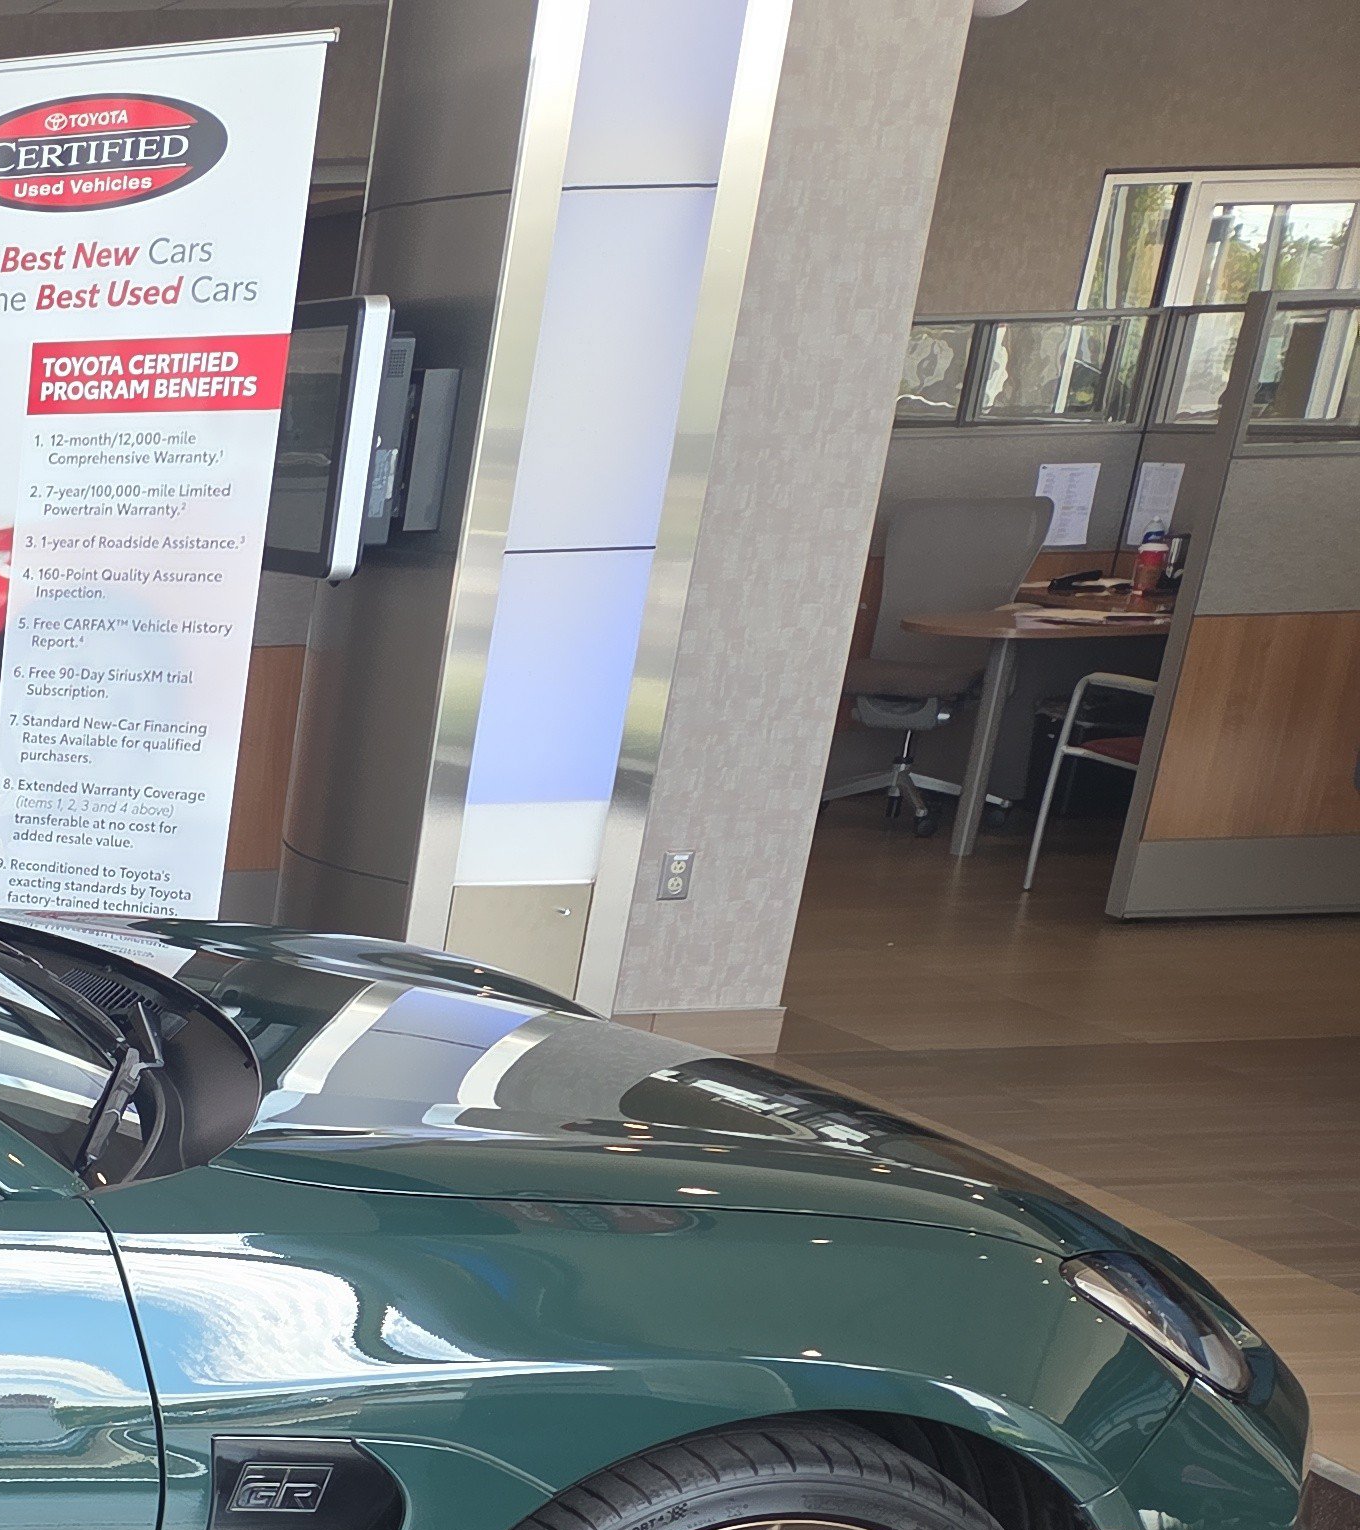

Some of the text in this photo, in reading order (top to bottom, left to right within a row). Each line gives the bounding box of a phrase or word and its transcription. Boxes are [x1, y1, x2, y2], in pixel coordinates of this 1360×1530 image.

[69, 110, 129, 127] TOYOTA
[14, 175, 153, 198] Used Vehicles
[0, 246, 66, 273] Best
[72, 242, 140, 269] New
[148, 237, 213, 265] Cars
[35, 283, 100, 311] Best
[107, 277, 184, 307] Used
[190, 276, 258, 304] Cars
[41, 351, 239, 377] TOYOTA CERTIFIED
[40, 376, 258, 401] PROGRAM BENEFITS
[34, 431, 197, 448] 1. 12-month/12,000-mile
[48, 451, 150, 467] Comprehensive
[30, 482, 231, 500] 2. 7-year/100,000-mile Limited
[43, 501, 113, 518] Powertrain
[25, 535, 37, 550] 3.
[41, 535, 79, 553] 1-year
[82, 535, 96, 550] of
[98, 535, 159, 551] Roadside
[22, 567, 223, 586] 4. 160-Point Quality Assurance
[36, 585, 106, 602] Inspection.
[18, 617, 30, 631] 5.
[33, 618, 60, 632] Free
[131, 619, 179, 634] Vehicle
[181, 619, 233, 637] History
[13, 666, 193, 685] 6. Free 90-Day SiriusXM trial
[26, 683, 109, 700] Subscription.
[9, 714, 207, 737] 7. Standard New-Car Financing
[22, 731, 201, 753] Rates Available for qualified
[20, 750, 92, 766] purchasers.
[3, 778, 206, 804] 8. Extended Warranty Coverage
[15, 797, 54, 813] (items
[81, 800, 89, 813] 3
[91, 800, 117, 815] and
[120, 802, 128, 815] 4
[130, 802, 174, 819] above)
[14, 813, 178, 835] transferable at no cost for
[13, 829, 134, 850] added resale value.
[10, 858, 99, 878] Reconditioned
[102, 864, 116, 879] to
[8, 875, 191, 902] exacting standards by Toyota
[7, 890, 178, 917] factory-trained technicians.
